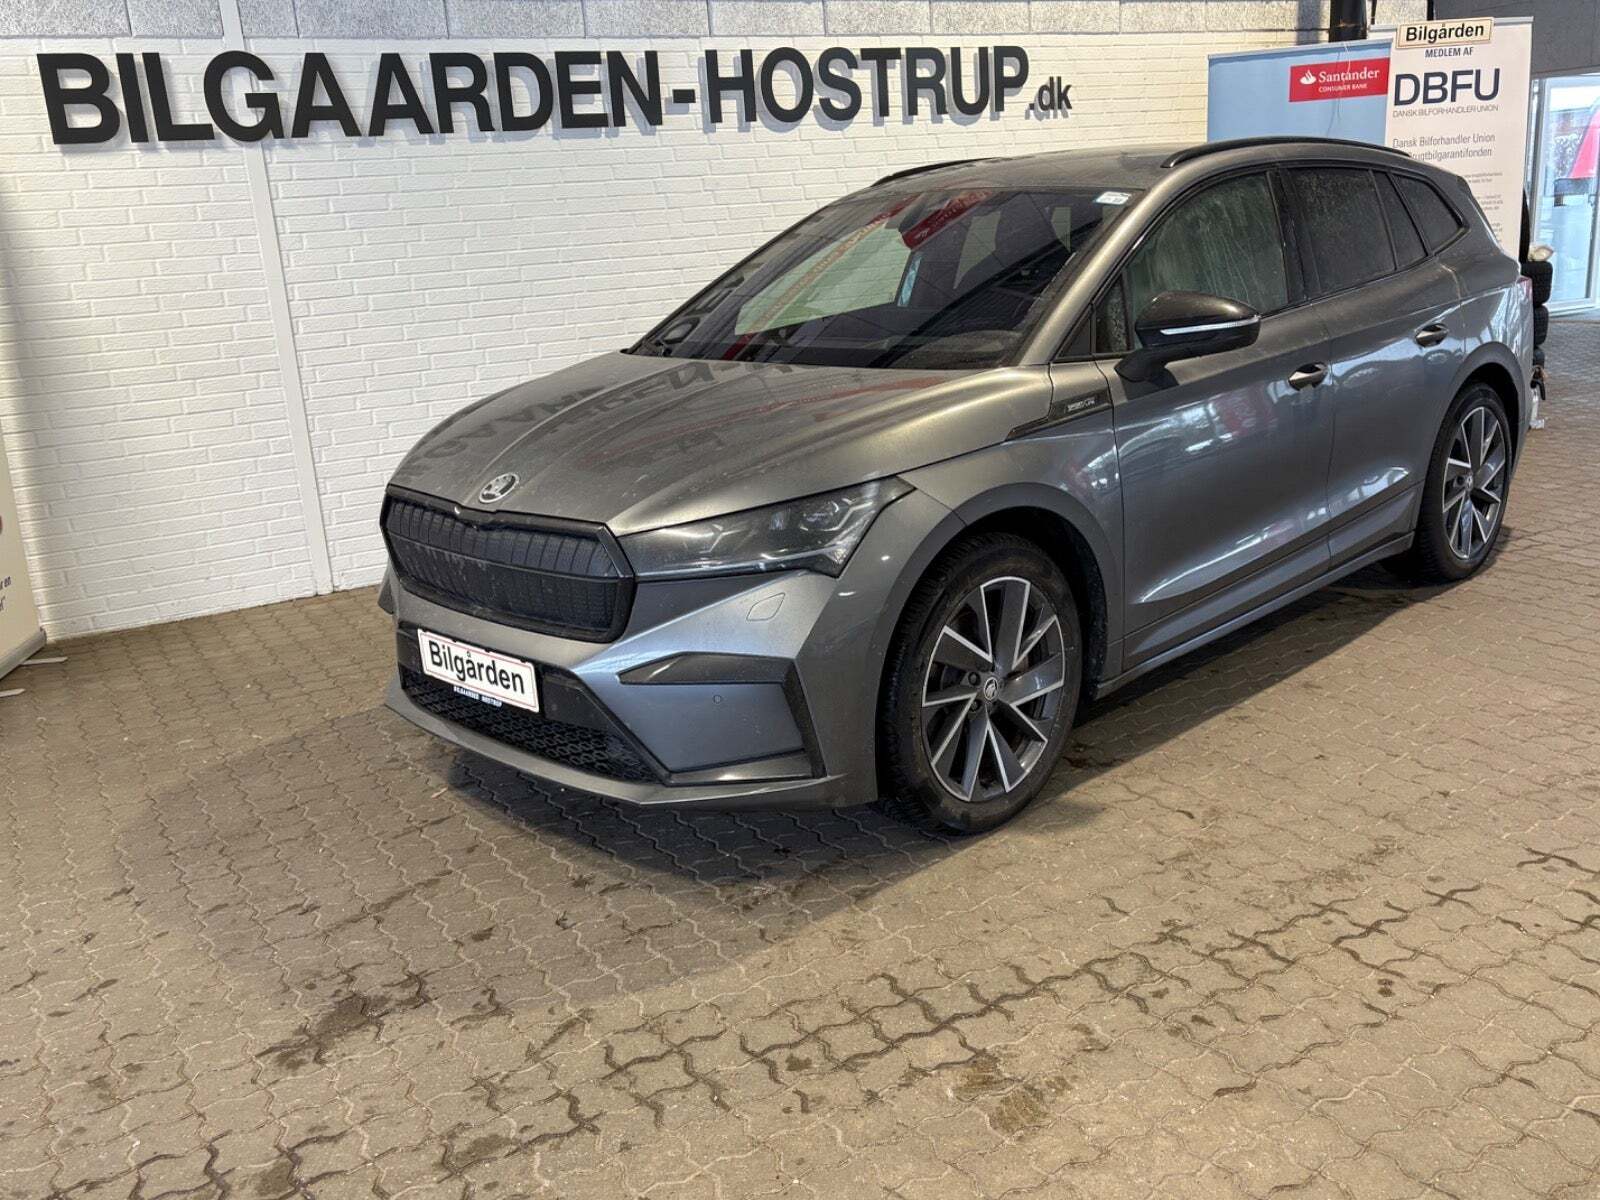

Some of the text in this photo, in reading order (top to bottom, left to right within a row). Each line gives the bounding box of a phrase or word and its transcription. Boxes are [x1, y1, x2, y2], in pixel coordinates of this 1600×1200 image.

[1406, 23, 1484, 44] Bilgården
[1425, 46, 1474, 58] MEDLEM AF
[1318, 66, 1380, 83] Santander
[1318, 84, 1351, 93] CONSUMER
[1393, 68, 1500, 106] DBFU
[1392, 132, 1496, 149] Dansk Bilforhandler Union
[1408, 147, 1492, 161] rugtbilgarantifonden
[428, 639, 525, 695] Bilgården
